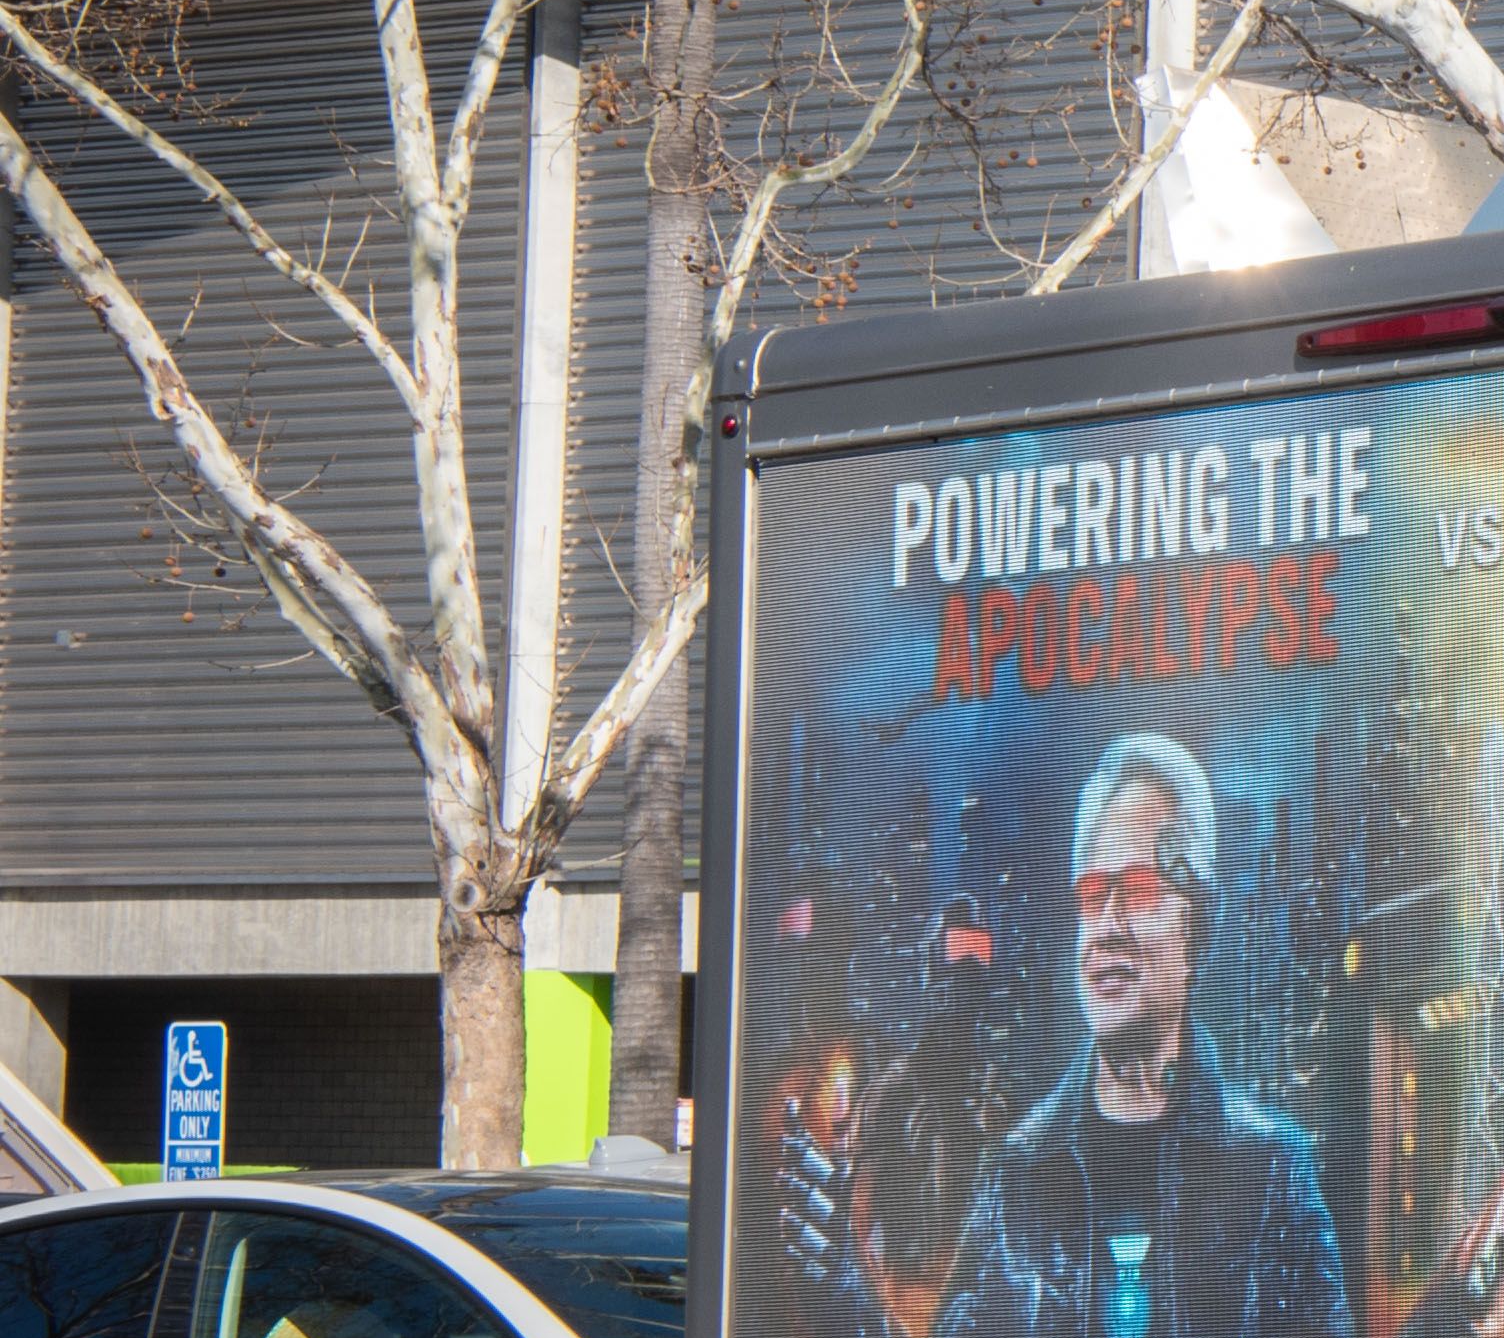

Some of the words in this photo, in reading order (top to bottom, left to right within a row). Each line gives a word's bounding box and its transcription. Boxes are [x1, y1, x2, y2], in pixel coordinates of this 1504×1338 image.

[893, 446, 1229, 587] POWERING
[1251, 428, 1373, 545] THE
[934, 552, 1341, 703] APOCALYPSE
[171, 1089, 220, 1112] PARKING
[179, 1115, 210, 1139] ONLY
[175, 1147, 212, 1163] MINIMUM
